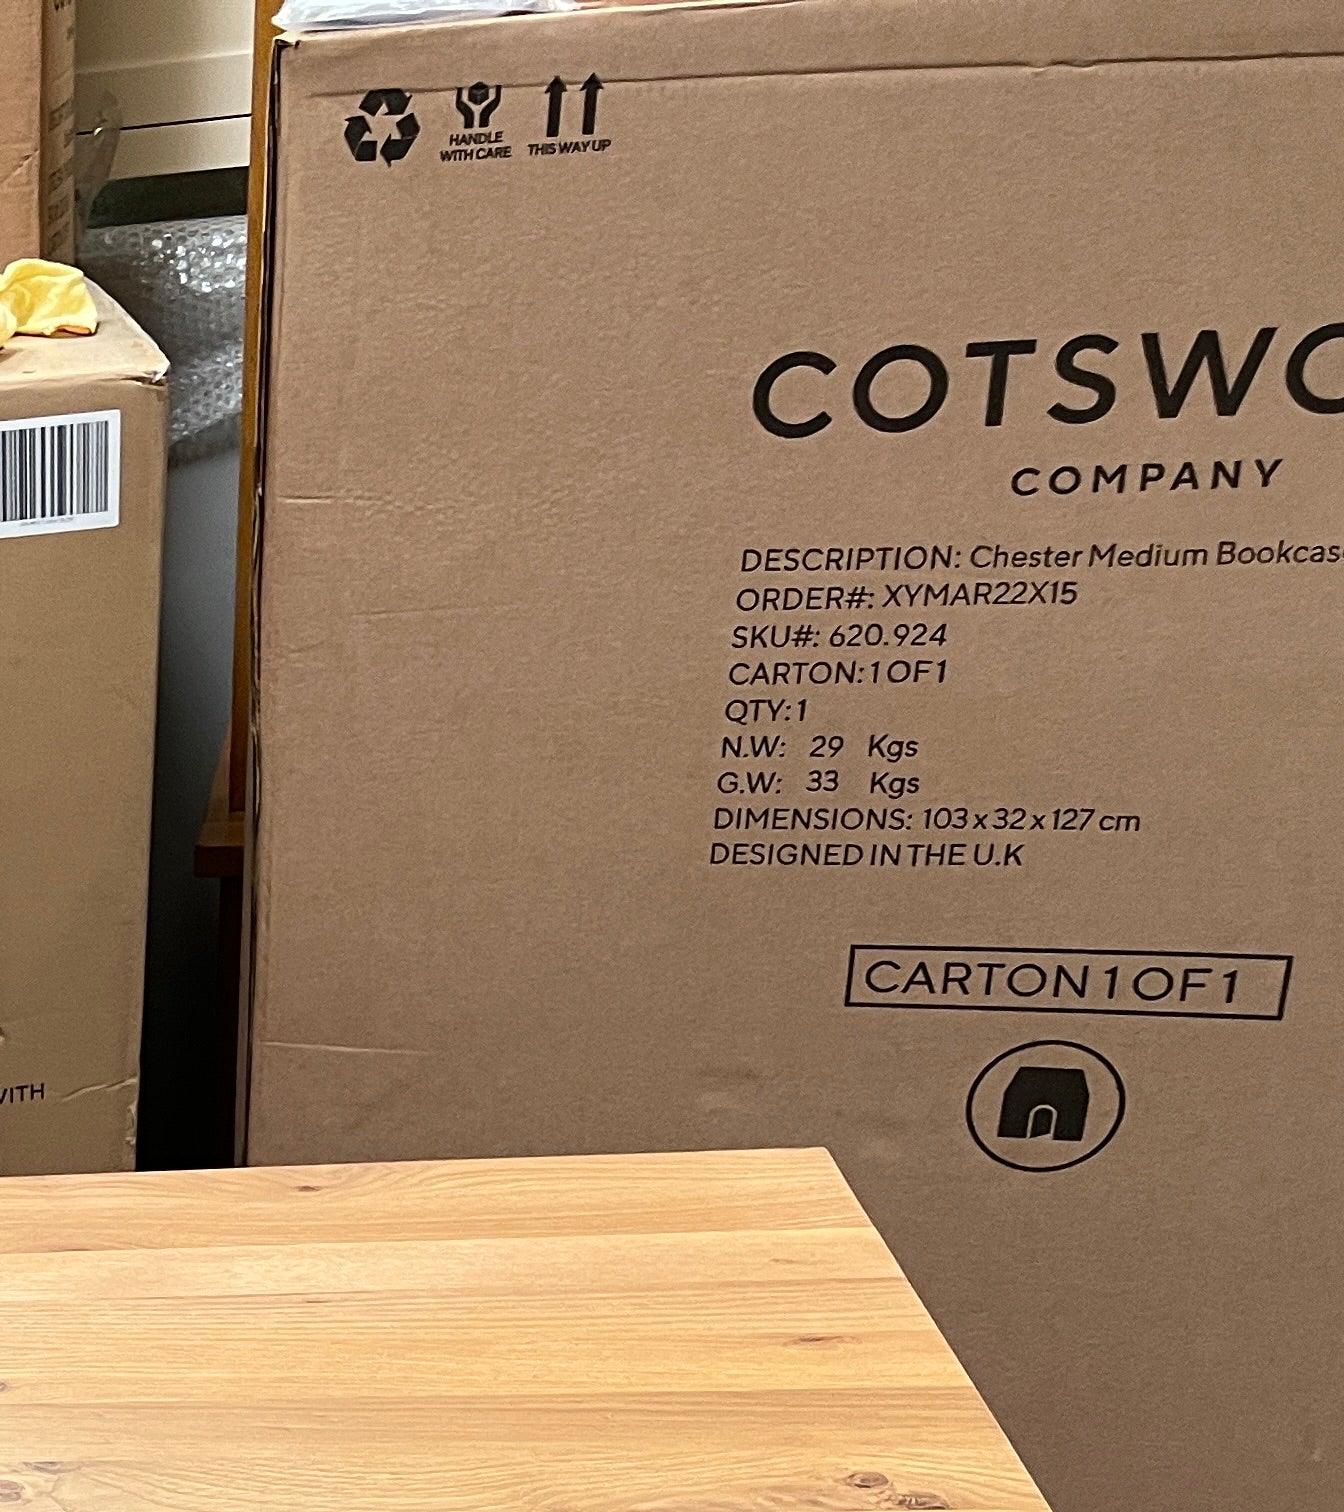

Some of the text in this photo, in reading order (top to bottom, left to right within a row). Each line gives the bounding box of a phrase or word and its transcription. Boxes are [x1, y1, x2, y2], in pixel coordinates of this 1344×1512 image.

[449, 131, 504, 146] HANDLE
[527, 139, 611, 156] THIS WAY UP
[440, 146, 512, 162] WITH CARE
[1011, 459, 1283, 496] COMPANY
[741, 540, 1344, 572] DESCRIPTION: Chester Medium Bookcas
[736, 581, 1078, 612] ORDER#: XYMAR22X15
[732, 623, 947, 648] SKU#: 620.924
[721, 734, 919, 763] N.W: 29 Kgs
[717, 770, 919, 799] G.W: 33 Kgs
[714, 808, 912, 831] DIMENSIONS:
[710, 843, 1025, 867] DESIGNED IN THE U.K
[865, 961, 1089, 998] CARTON
